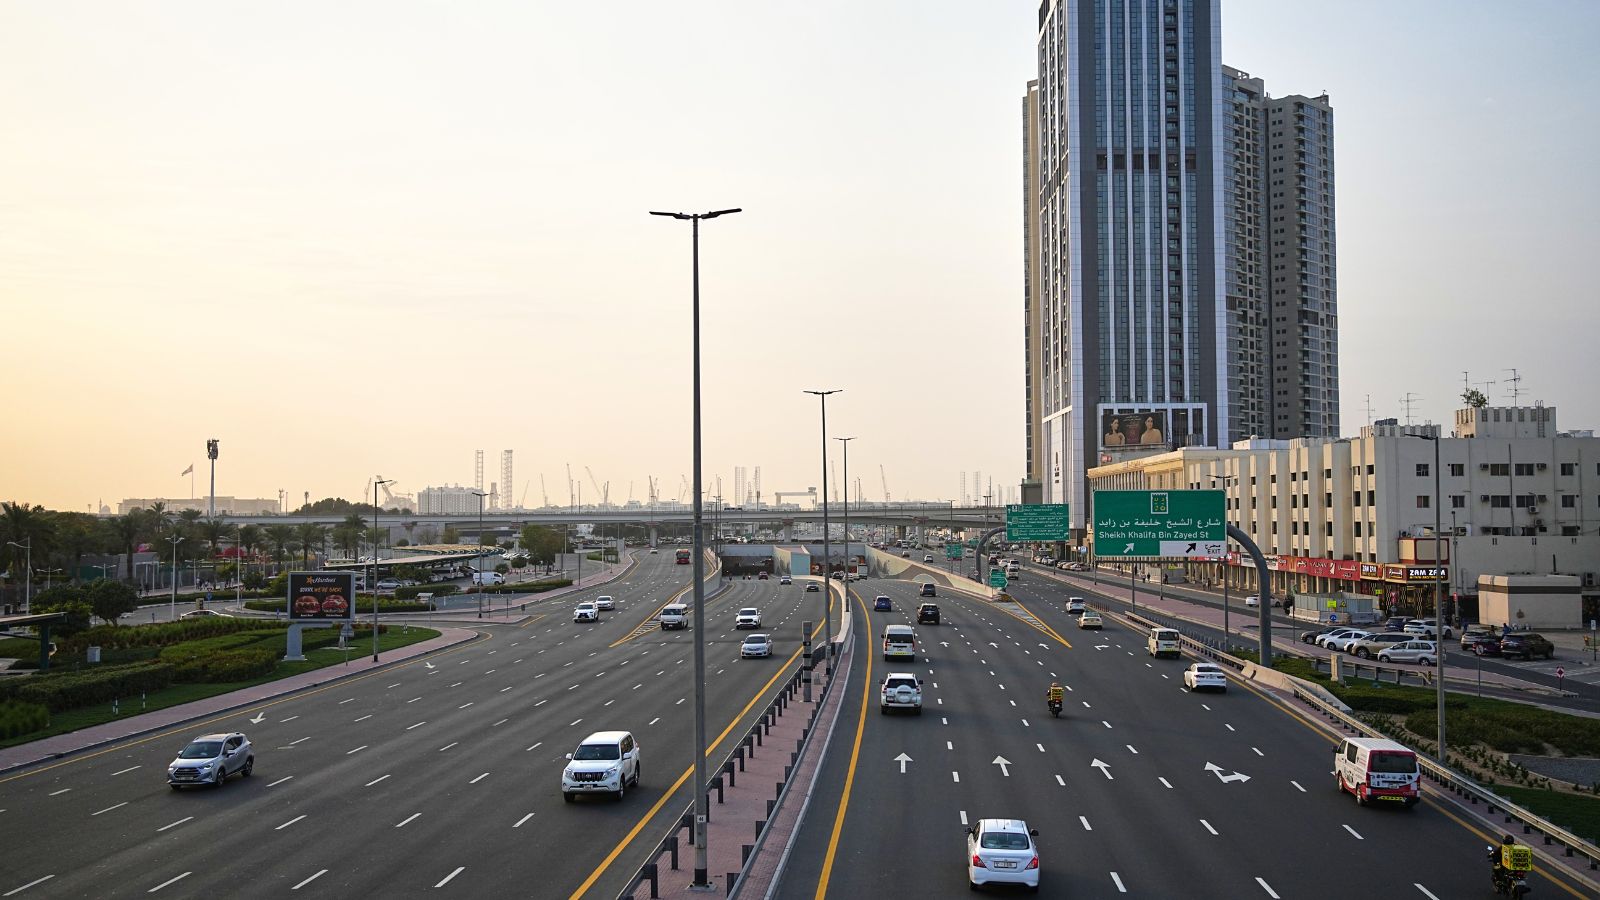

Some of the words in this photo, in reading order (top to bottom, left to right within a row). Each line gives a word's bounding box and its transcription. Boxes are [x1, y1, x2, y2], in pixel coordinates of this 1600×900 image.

[1098, 518, 1116, 528] زايد
[1120, 520, 1130, 528] بن
[1134, 518, 1162, 528] خليفة
[1166, 518, 1192, 528] الشيخ
[1197, 518, 1221, 528] شارع
[1174, 531, 1198, 540] Zayed
